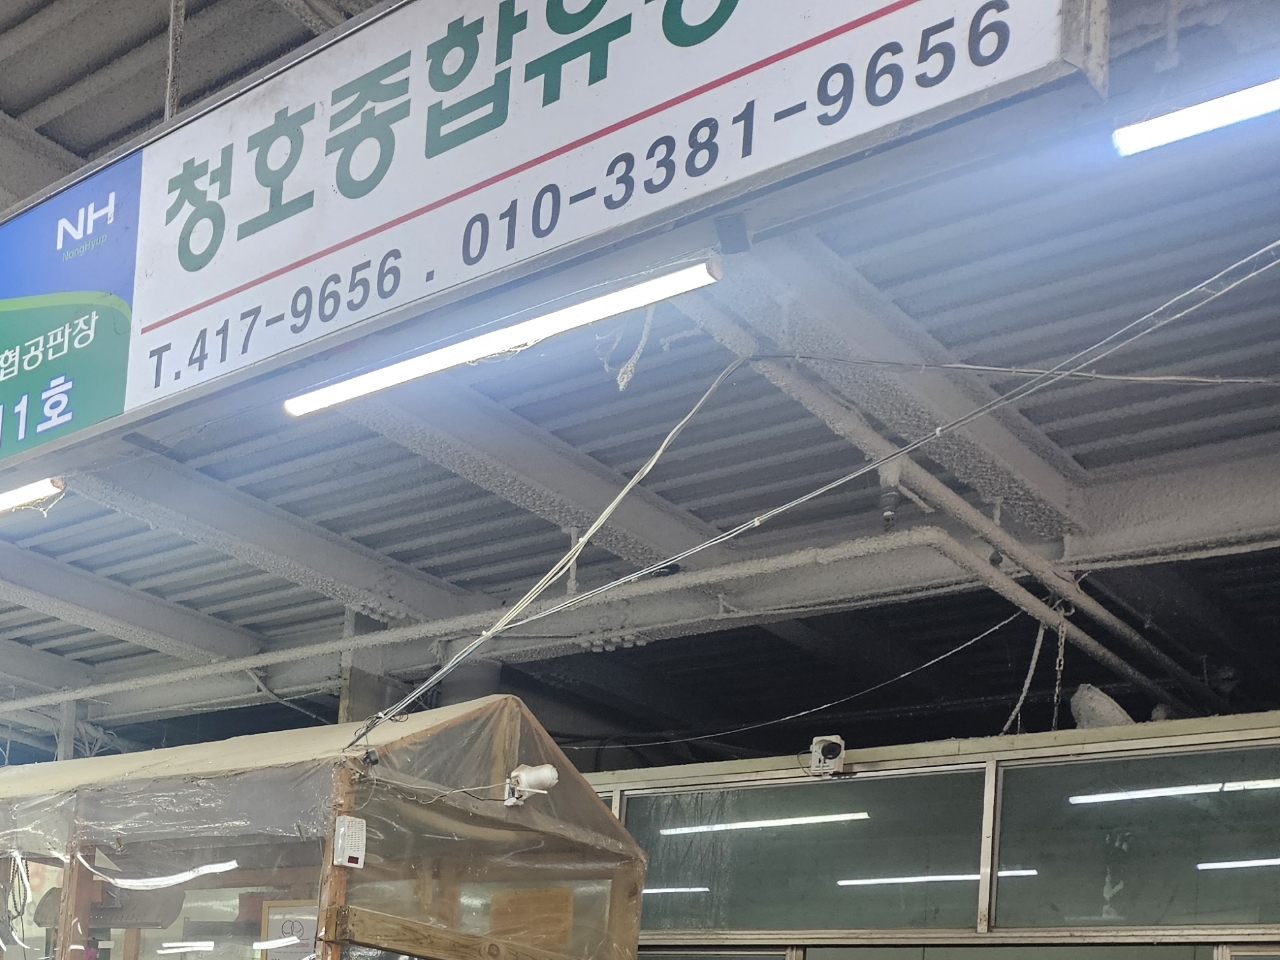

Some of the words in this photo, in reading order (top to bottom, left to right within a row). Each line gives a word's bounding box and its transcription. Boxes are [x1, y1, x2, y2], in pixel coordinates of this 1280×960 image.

[148, 247, 402, 389] T.417-9656
[461, 0, 1011, 267] 010-3381-9656
[165, 0, 739, 272] 청호종합유
[55, 190, 116, 251] NH
[61, 232, 108, 263] NongHyup
